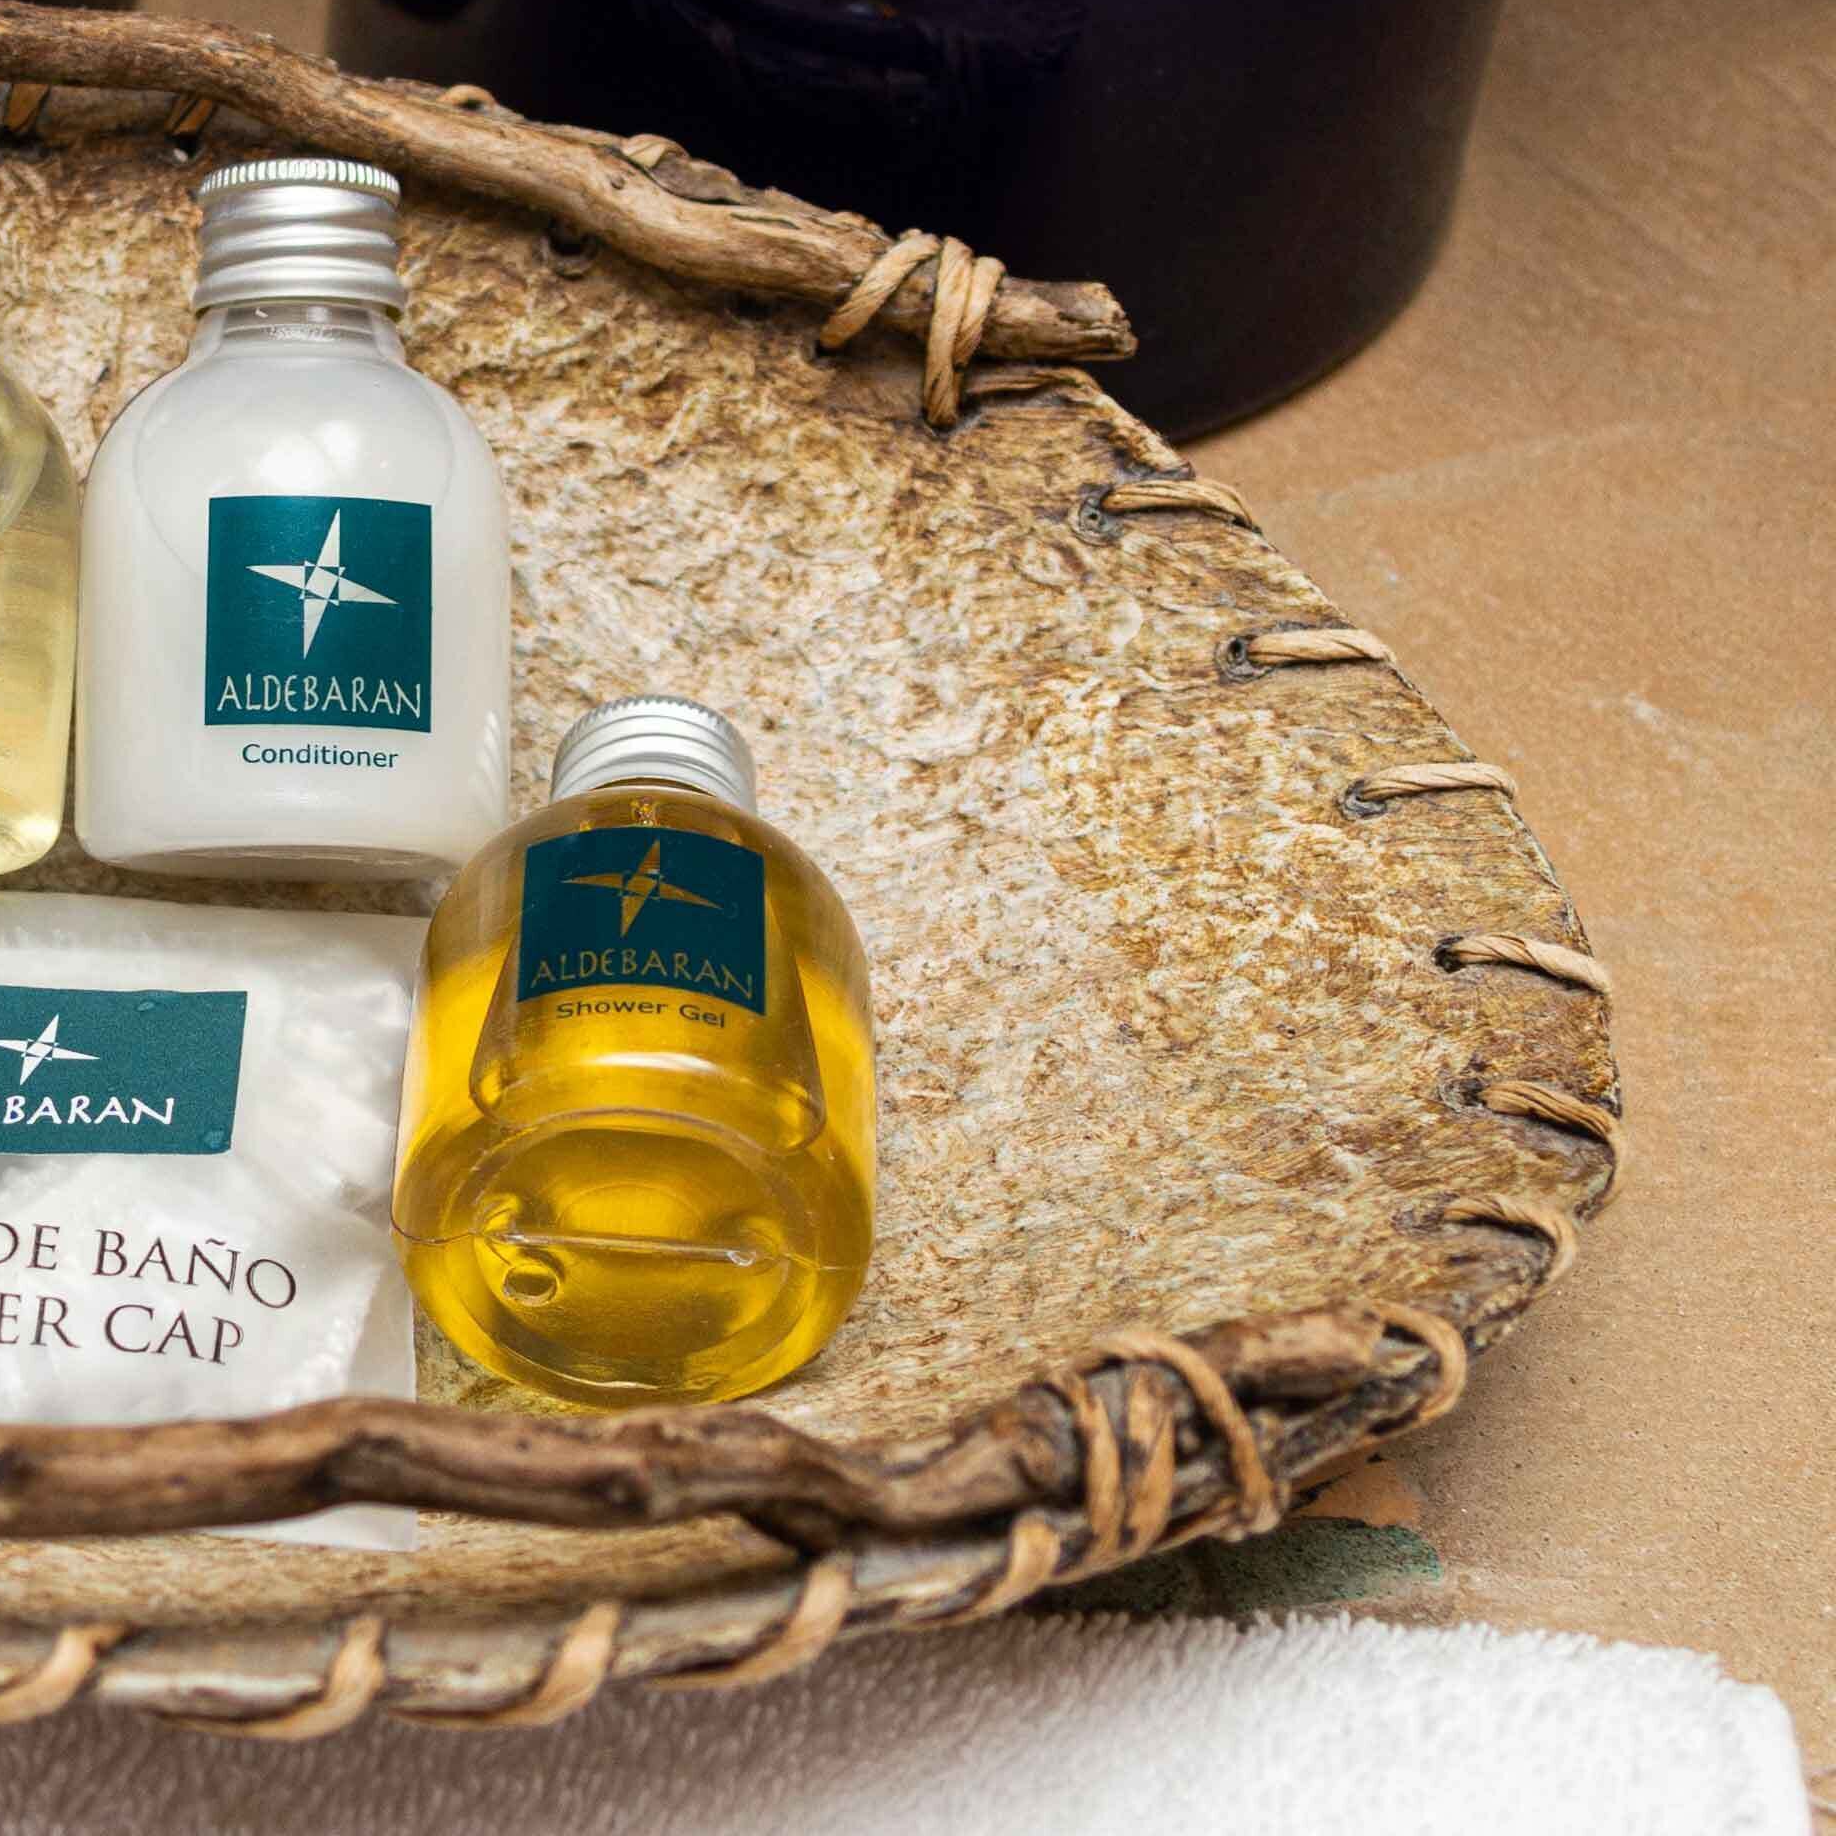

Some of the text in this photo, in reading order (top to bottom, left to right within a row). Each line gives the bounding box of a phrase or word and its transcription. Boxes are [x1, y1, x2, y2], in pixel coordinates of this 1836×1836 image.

[216, 674, 421, 718] ALDEBARAN
[241, 743, 399, 768] Conditioner
[530, 948, 754, 1000] ALDEBARAN
[556, 1000, 725, 1028] Shower Gel
[92, 1229, 298, 1310] BAÑO
[104, 1304, 245, 1366] CAP
